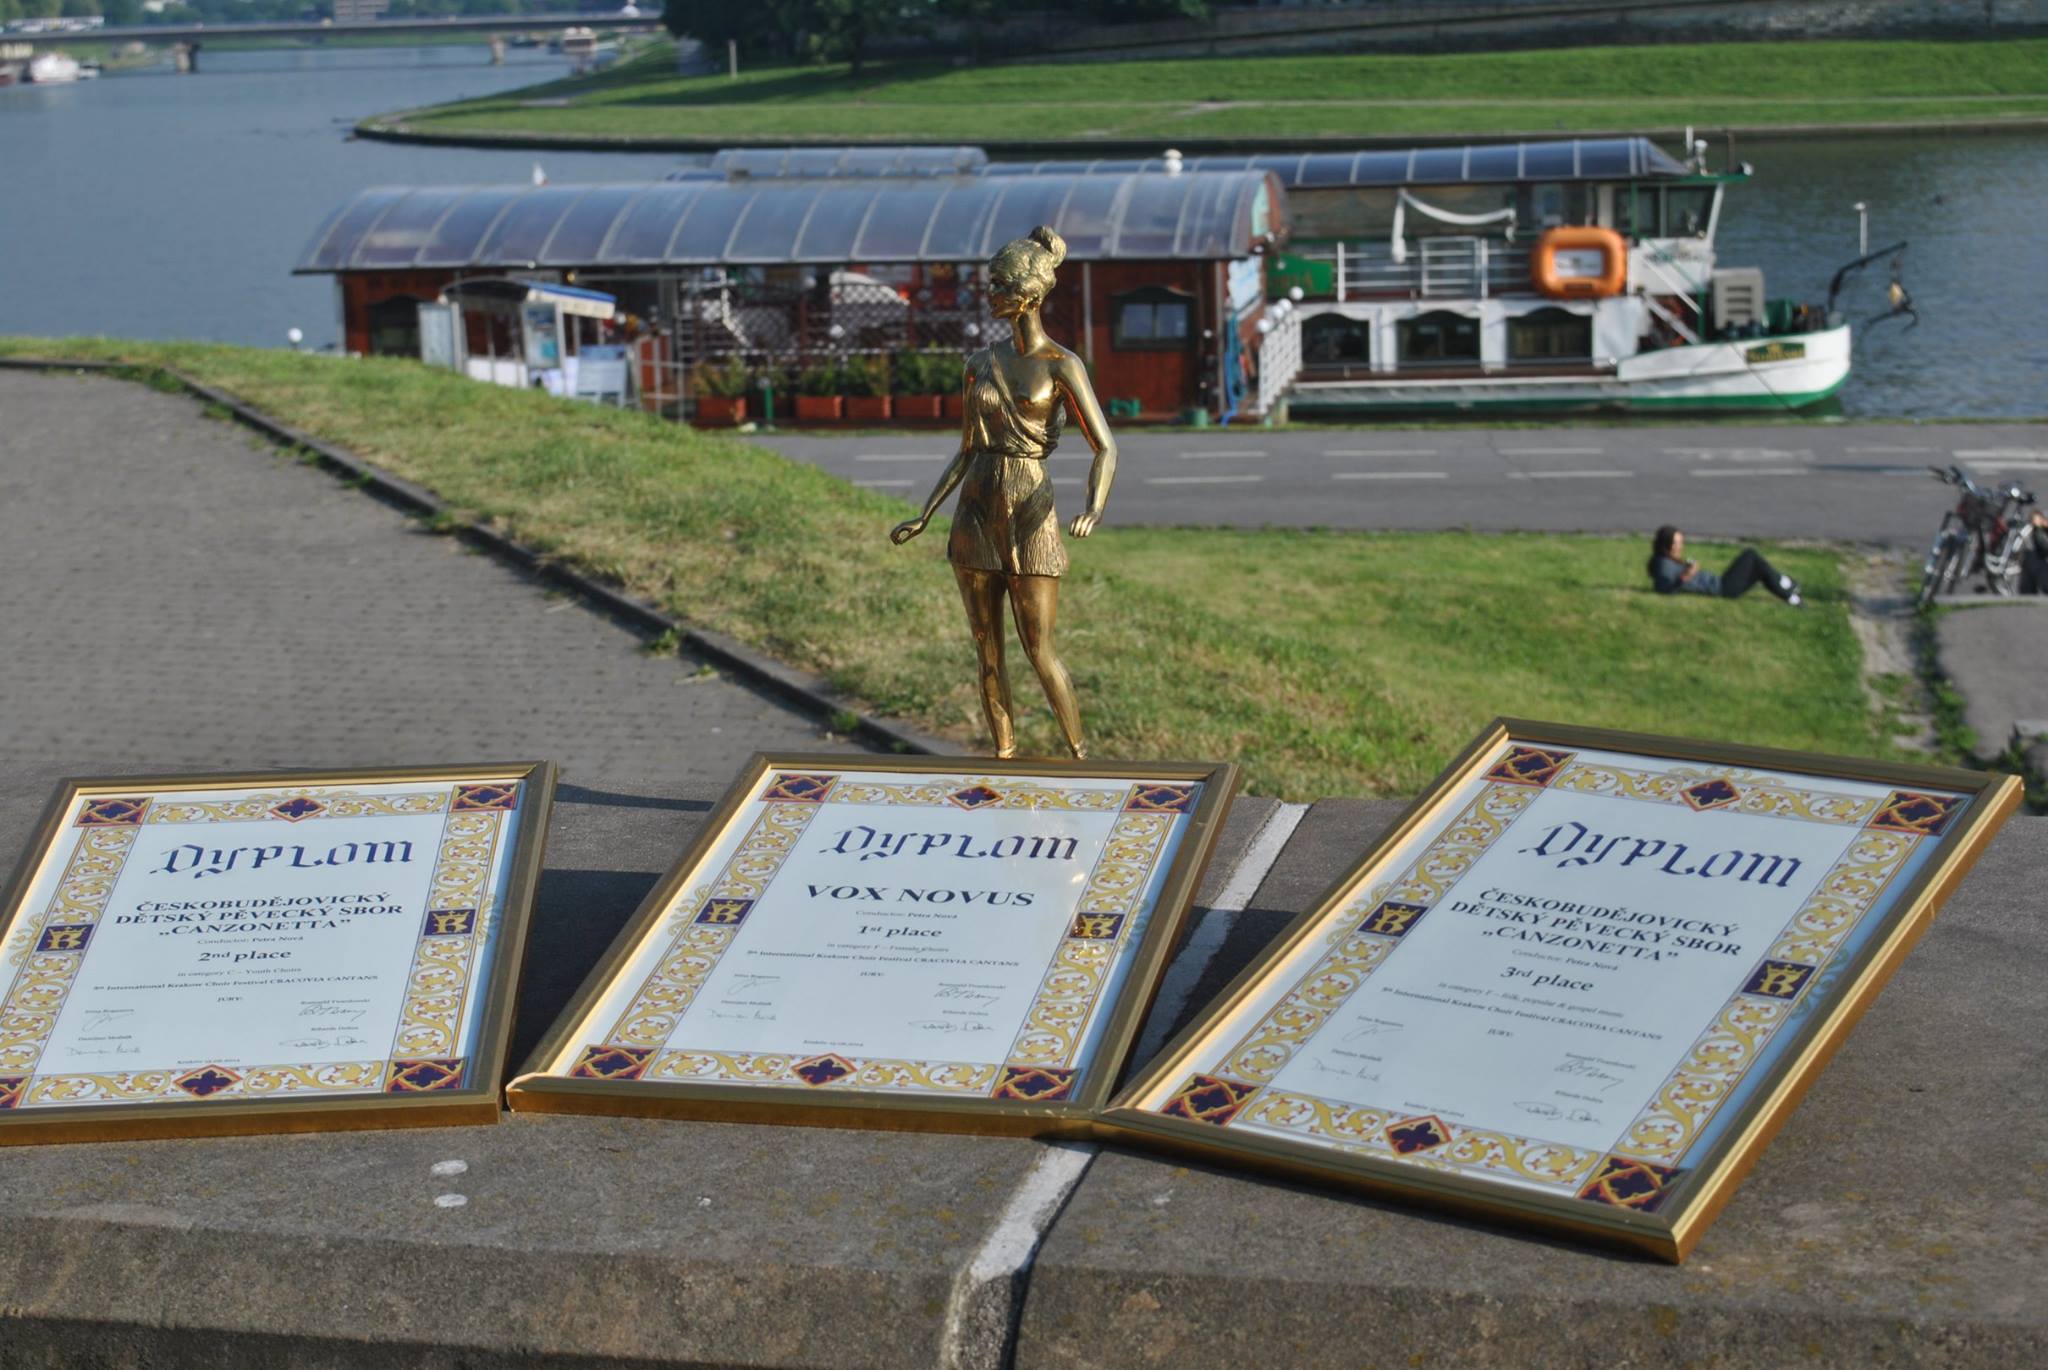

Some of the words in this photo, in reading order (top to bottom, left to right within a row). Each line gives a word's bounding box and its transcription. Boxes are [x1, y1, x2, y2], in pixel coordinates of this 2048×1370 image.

[136, 892, 391, 913] ČESKOBUDĚJOVICKÝ
[807, 885, 890, 901] VOX
[897, 888, 1035, 907] NOVUS
[115, 911, 215, 925] DĚTSKÝ
[218, 905, 333, 921] PĚVECKÝ
[338, 905, 403, 916] SBOR
[1479, 888, 1739, 936] ČESKOBUDĚJOVICKÝ
[857, 925, 884, 935] 1st
[885, 926, 943, 938] place
[1449, 901, 1550, 926] DĚTSKÝ
[1551, 915, 1670, 943] PĚVECKÝ
[1671, 936, 1742, 957] SBOR
[198, 951, 231, 962] 2nd
[234, 950, 292, 963] place
[1500, 966, 1534, 979] 3rd
[1532, 974, 1595, 992] place
